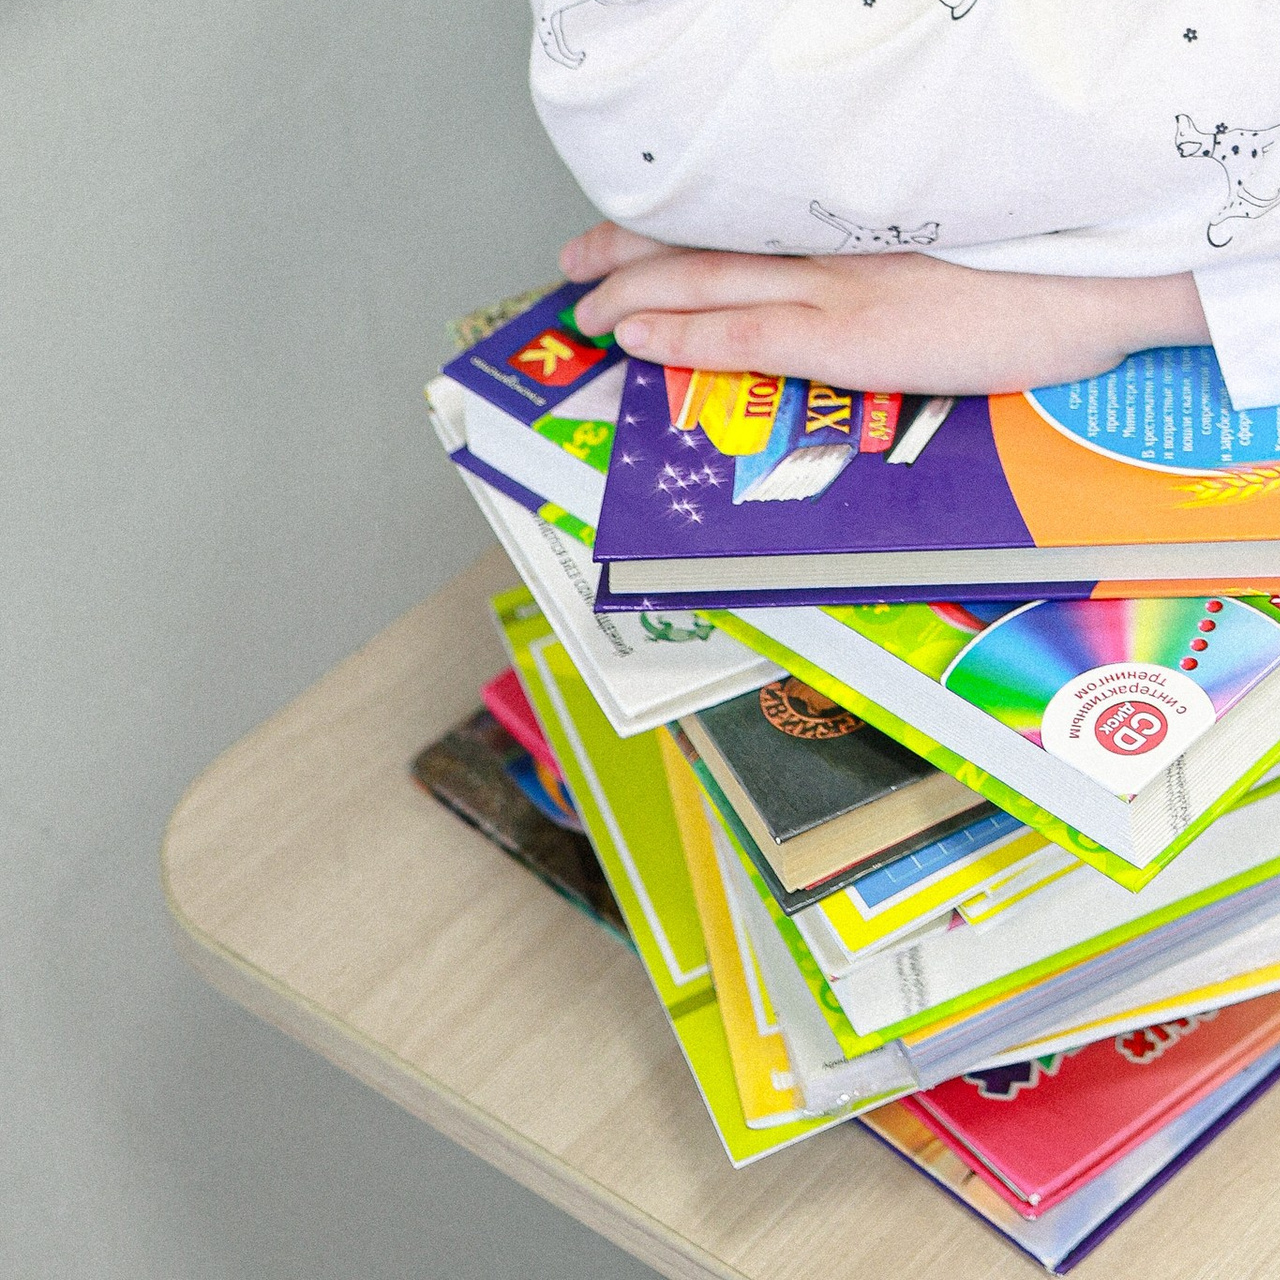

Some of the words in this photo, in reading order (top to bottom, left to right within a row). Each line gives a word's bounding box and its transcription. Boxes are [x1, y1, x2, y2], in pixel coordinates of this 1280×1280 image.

[1074, 671, 1167, 700] тренингом
[1069, 683, 1178, 739] интерактивным
[1113, 712, 1162, 751] CD
